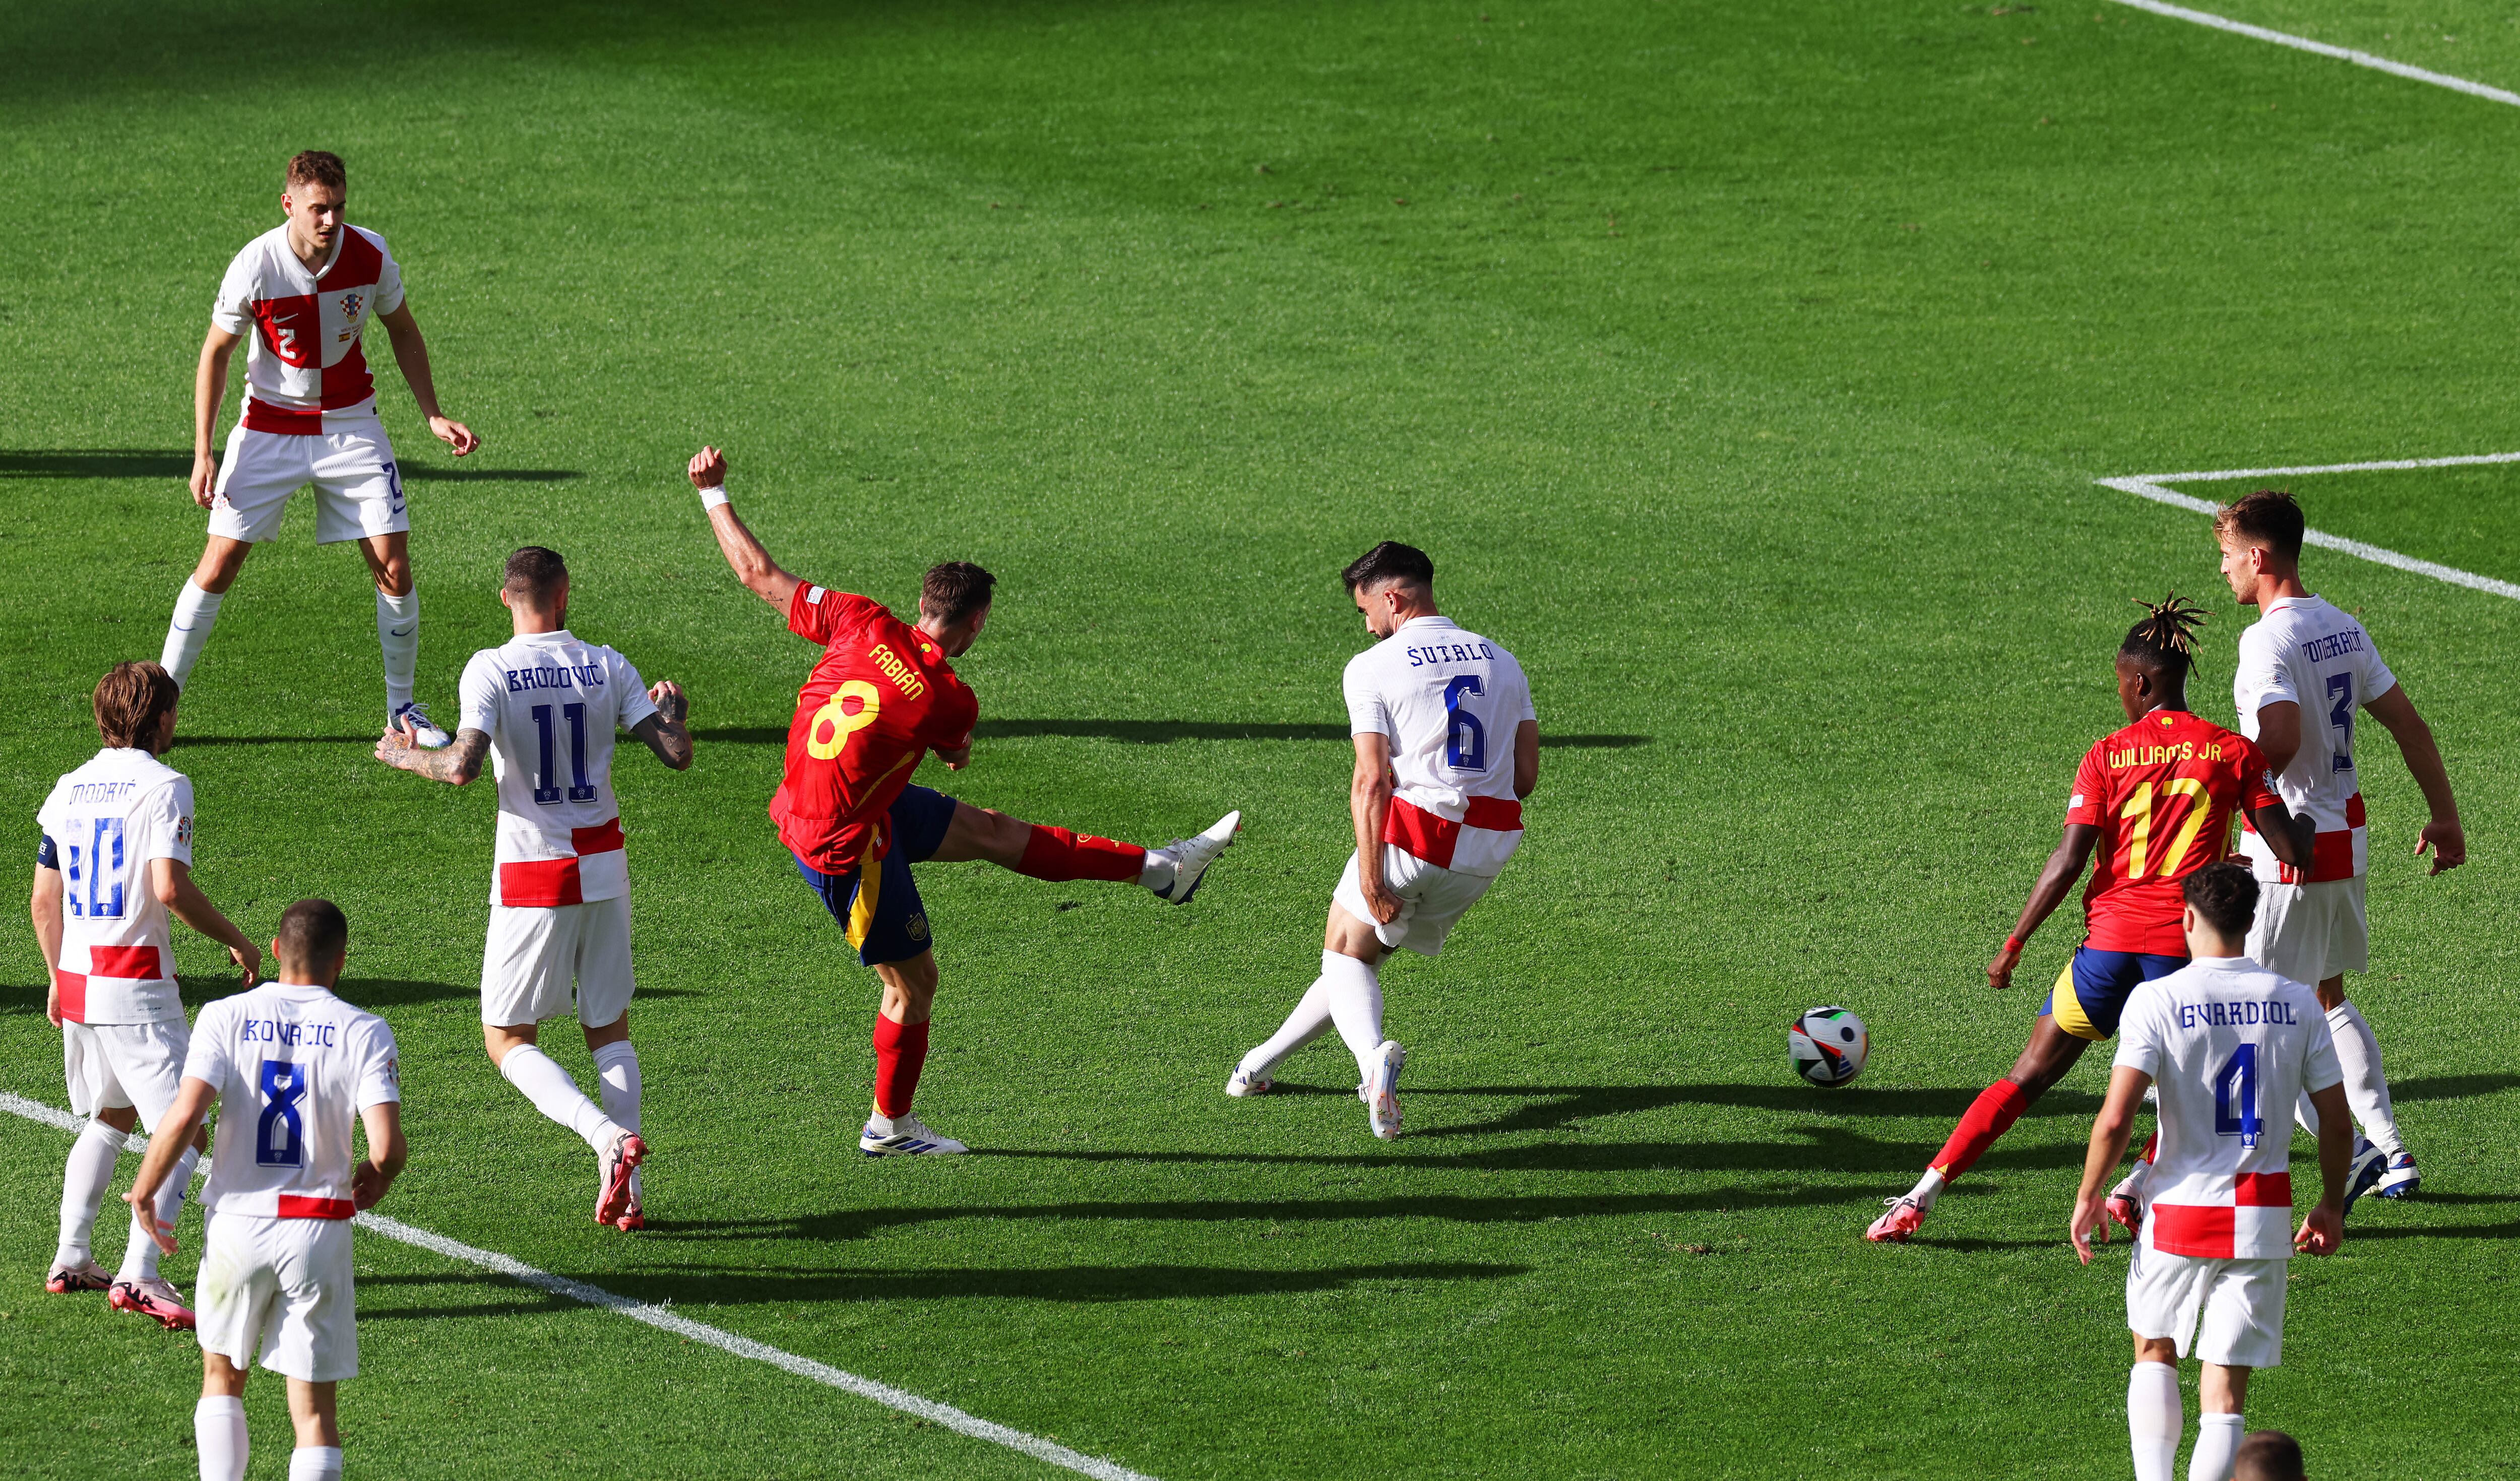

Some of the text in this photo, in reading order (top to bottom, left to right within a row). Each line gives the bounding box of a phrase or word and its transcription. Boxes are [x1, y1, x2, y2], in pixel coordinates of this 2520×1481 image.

[278, 329, 296, 360] 2
[382, 462, 403, 500] 2
[507, 661, 604, 692] BROZOVIĆ
[868, 644, 924, 701] FABIÁN
[1407, 643, 1495, 667] ŠUTALO
[807, 680, 879, 760] 8
[1443, 675, 1487, 772] 6
[2326, 672, 2354, 774] 3
[532, 702, 598, 805] 11
[2110, 741, 2226, 769] WILLIAMS JR.
[70, 779, 136, 805] MODRIĆ
[2120, 778, 2212, 879] 17
[66, 817, 126, 920] 10
[243, 1020, 335, 1048] KOVAČIĆ
[2182, 1001, 2297, 1028] GVARDIOL
[256, 1060, 307, 1169] 8
[2216, 1043, 2264, 1149] 4
